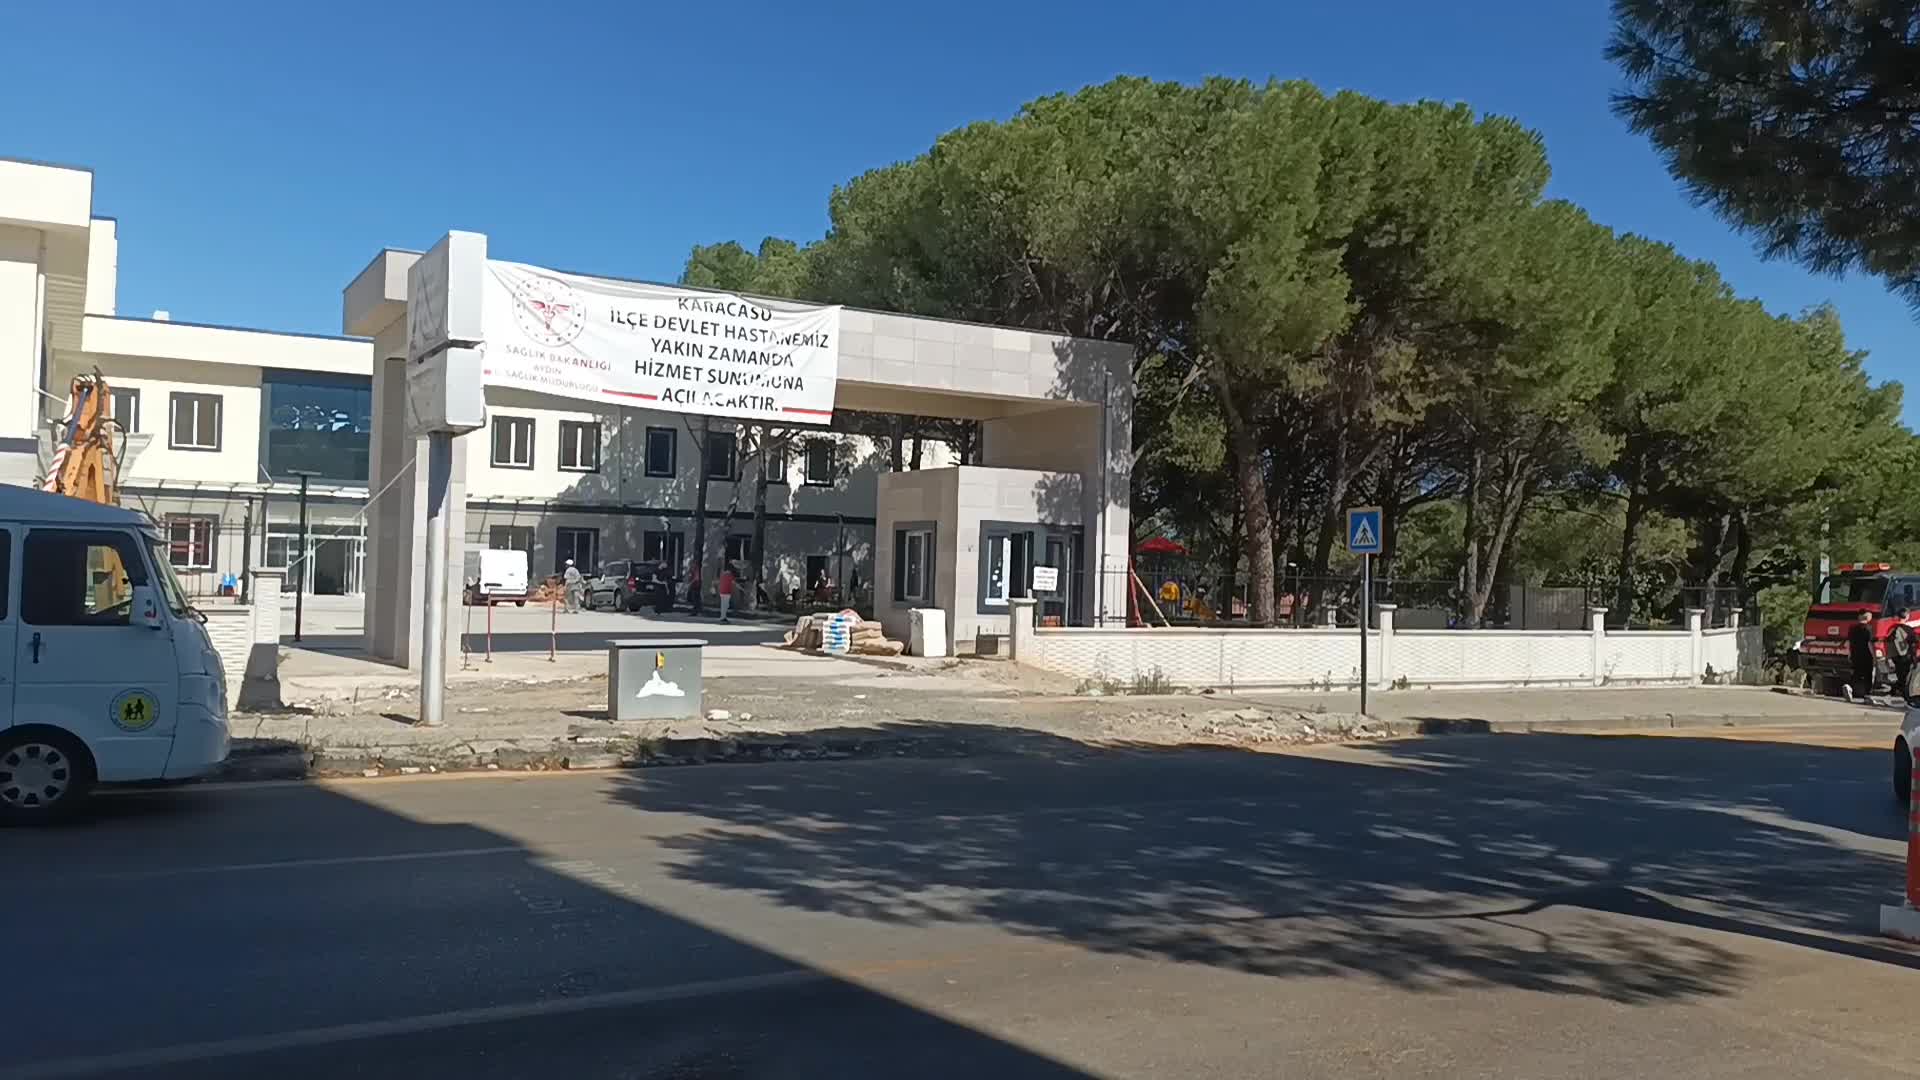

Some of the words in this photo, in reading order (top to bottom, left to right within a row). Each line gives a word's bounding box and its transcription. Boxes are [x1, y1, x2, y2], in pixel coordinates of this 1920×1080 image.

[610, 307, 649, 331] İLÇE
[654, 314, 720, 337] DEVLET
[678, 297, 772, 322] KARACASU
[651, 337, 703, 359] YAKIN
[708, 345, 794, 368] ZAMANDA
[635, 357, 703, 382] HİZMET
